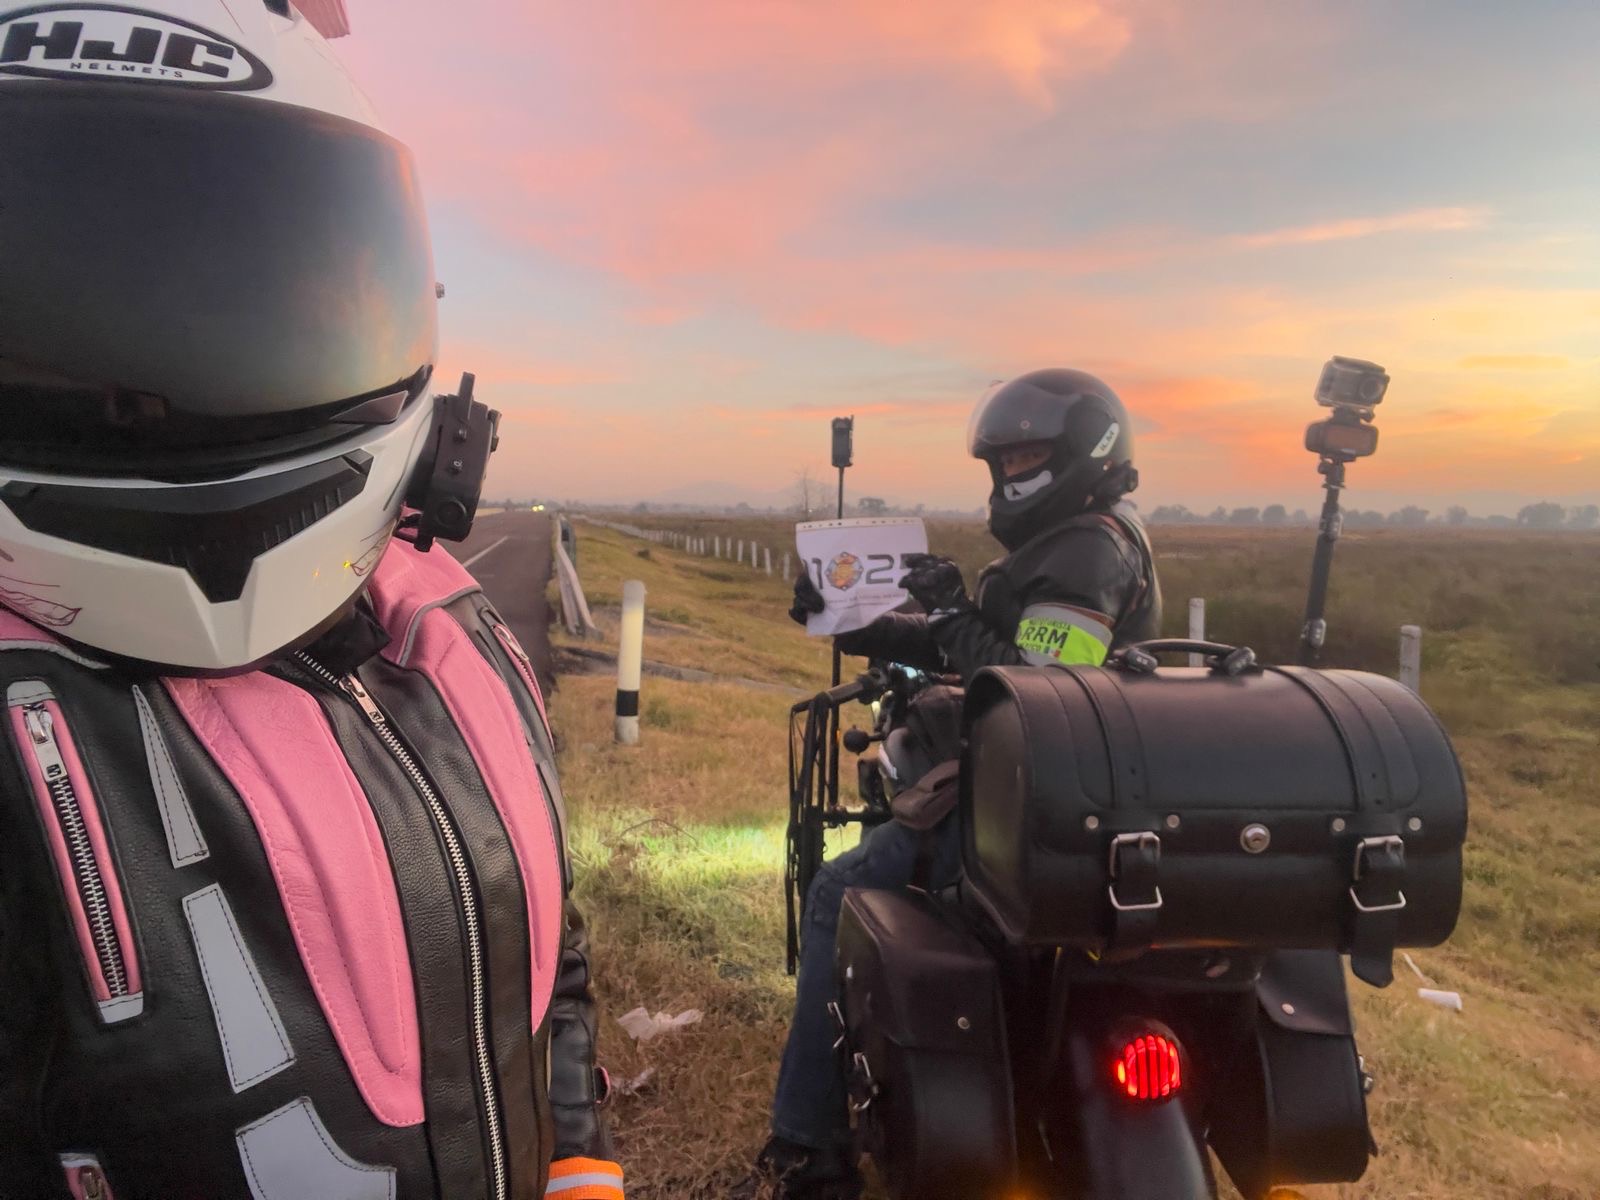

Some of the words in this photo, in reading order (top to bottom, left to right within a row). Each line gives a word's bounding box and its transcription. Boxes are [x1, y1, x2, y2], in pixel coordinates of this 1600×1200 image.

[0, 21, 234, 79] HJC
[70, 62, 183, 78] HELMETS
[1021, 626, 1069, 649] RRM
